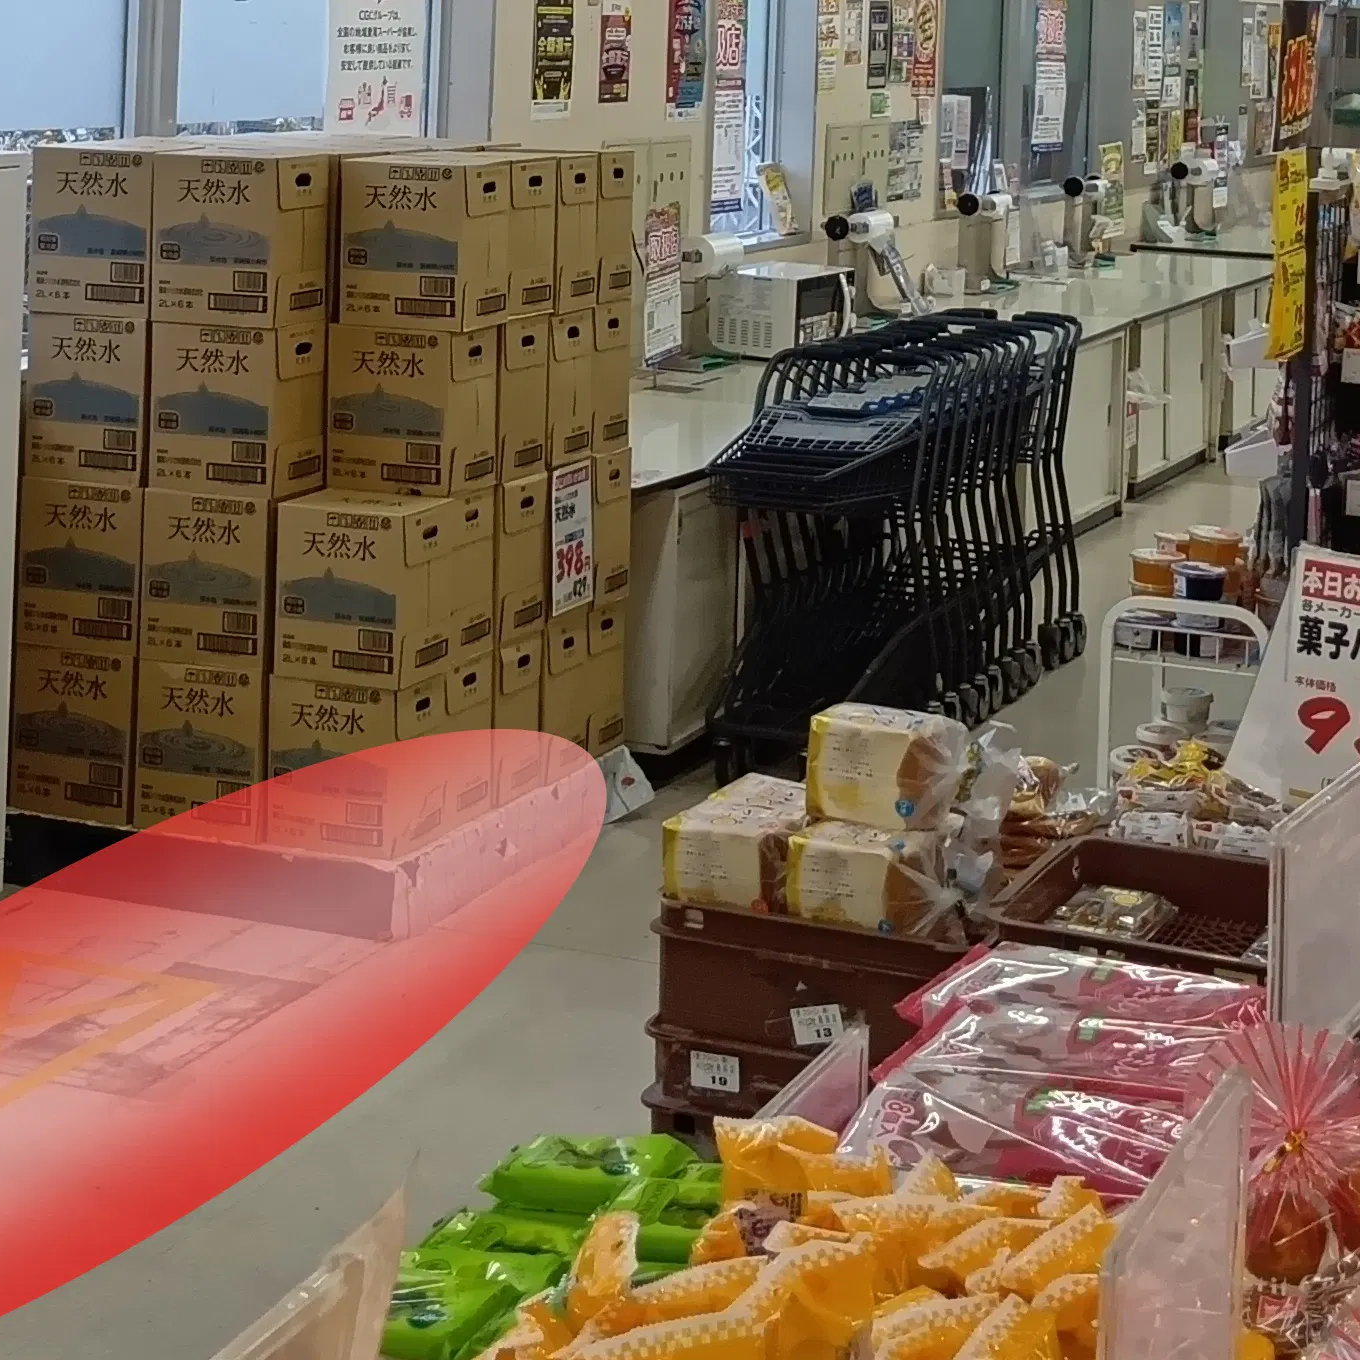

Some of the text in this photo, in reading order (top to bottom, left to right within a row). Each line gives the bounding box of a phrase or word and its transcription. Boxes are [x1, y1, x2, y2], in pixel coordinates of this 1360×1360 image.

[56, 172, 130, 196] 天然水
[179, 178, 252, 205] 天然水
[364, 183, 439, 210] 天然水
[51, 337, 121, 363] 天然水
[176, 348, 251, 374] 天然水
[352, 349, 425, 376] 天然水
[45, 504, 117, 532] 天然水
[167, 515, 241, 545] 天然水
[302, 531, 377, 560] 天然水
[556, 540, 584, 584] 398
[39, 668, 108, 699] 天然水
[1294, 675, 1336, 692] 本体価格
[161, 685, 235, 716] 天然水
[290, 703, 365, 734] 天然水
[814, 1027, 833, 1038] 13
[710, 1075, 728, 1086] 19
